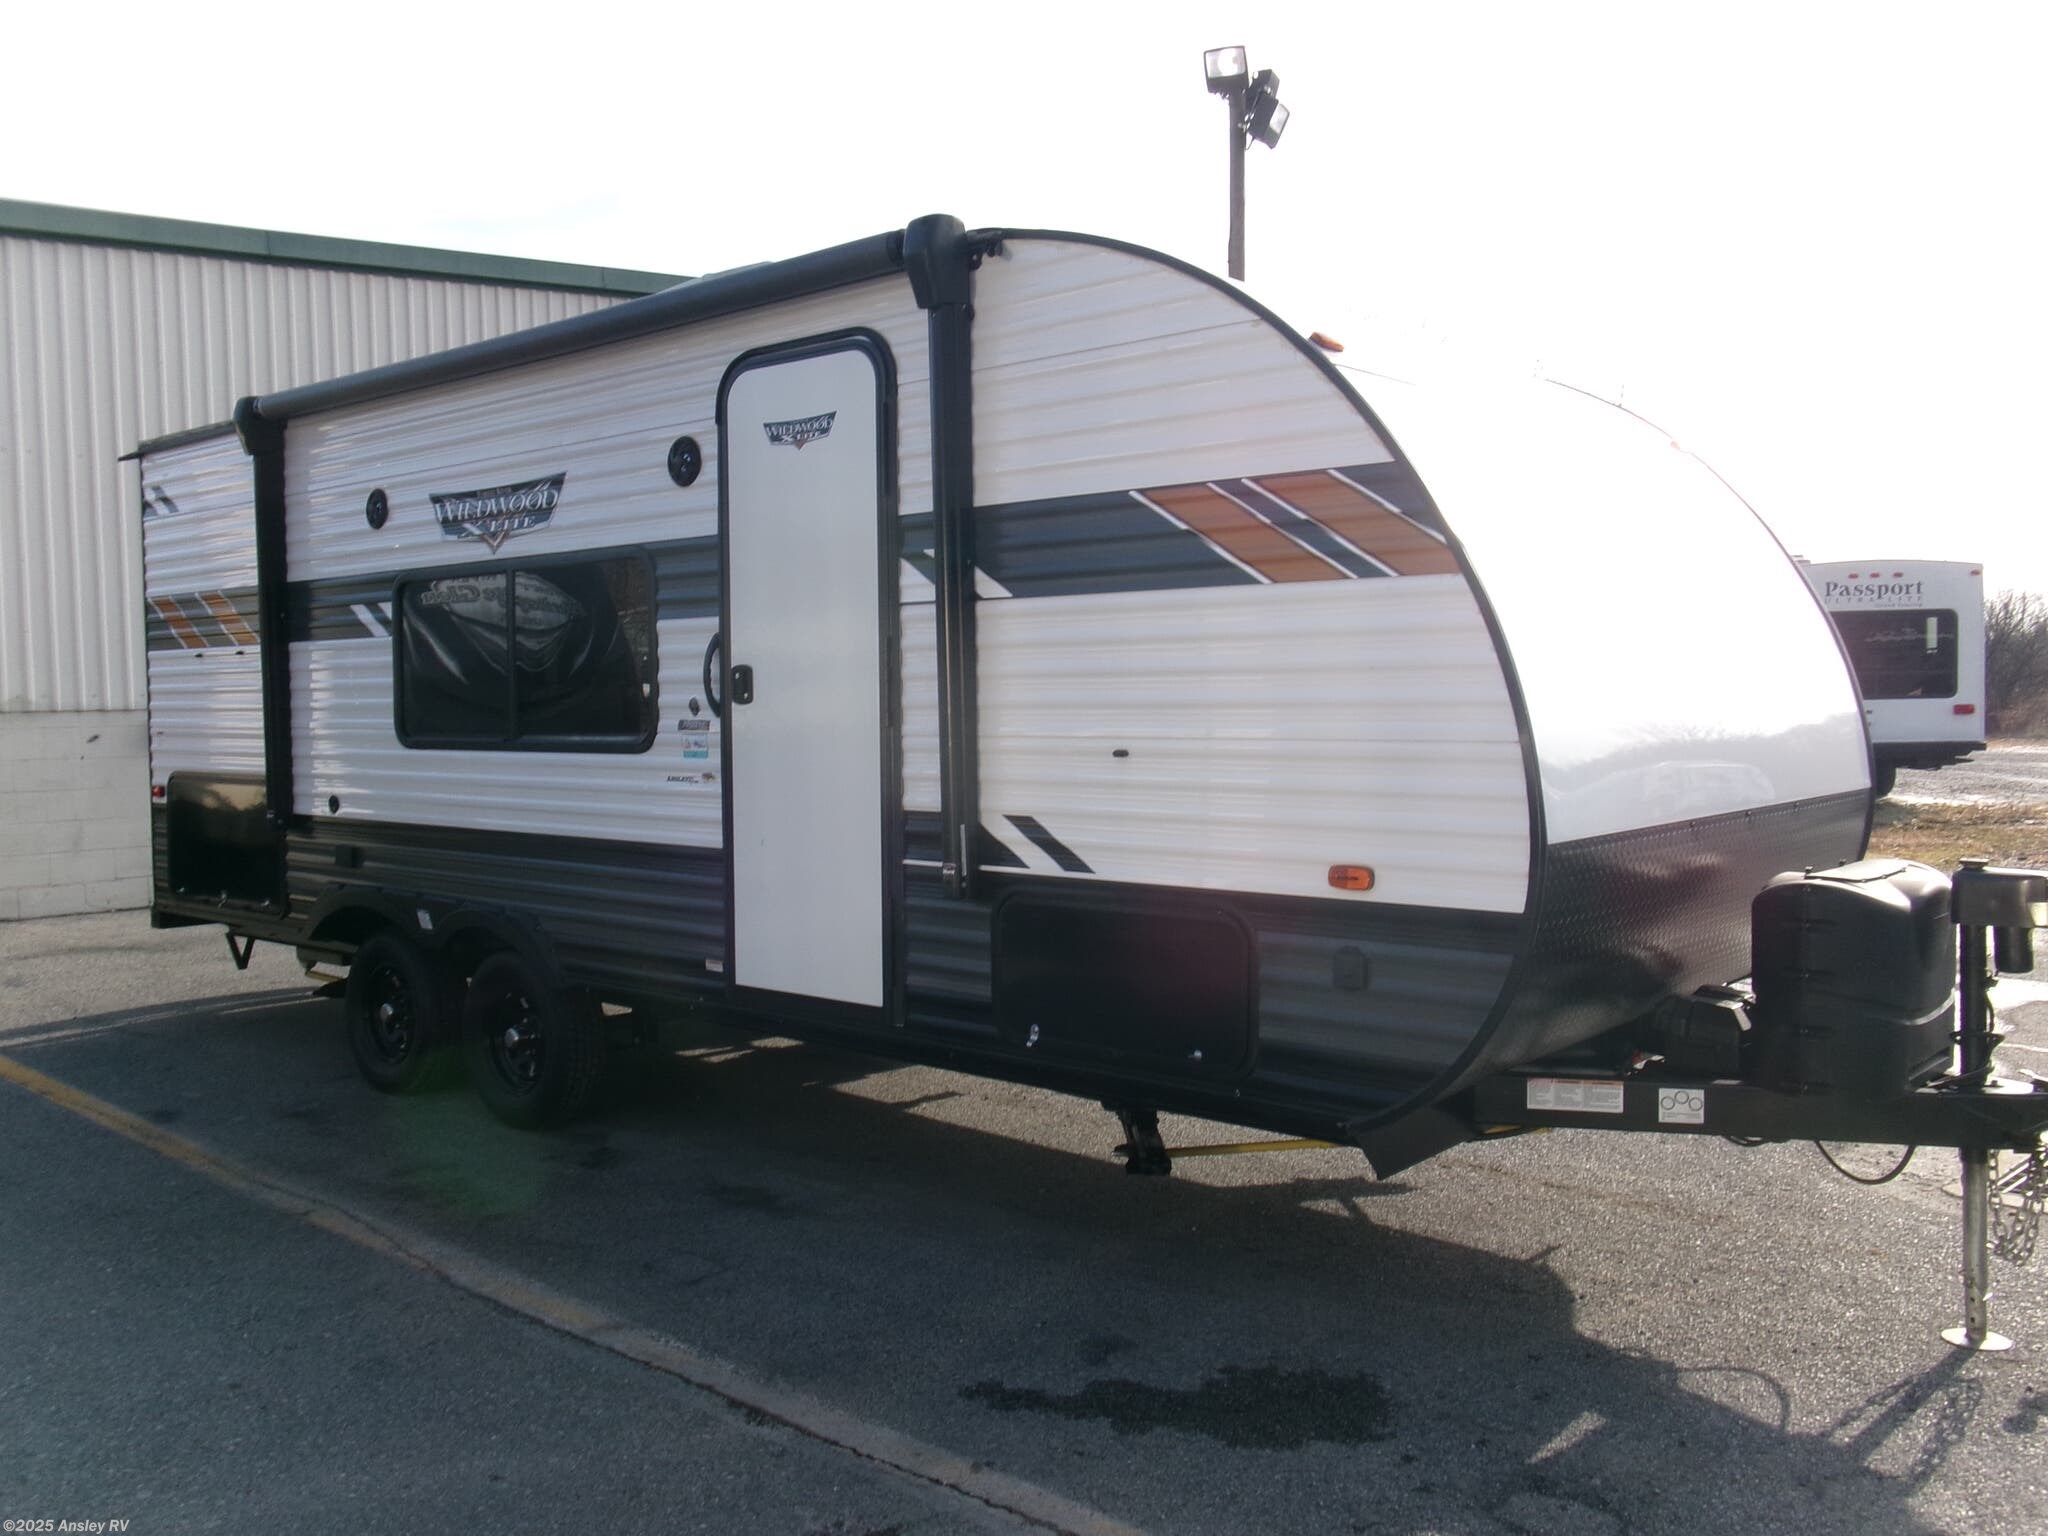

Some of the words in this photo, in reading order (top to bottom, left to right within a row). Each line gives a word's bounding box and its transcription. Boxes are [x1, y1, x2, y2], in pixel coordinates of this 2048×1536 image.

[765, 419, 833, 436] WILDWOOD
[433, 488, 559, 520] WILDWOOD
[1825, 580, 1924, 600] Passport
